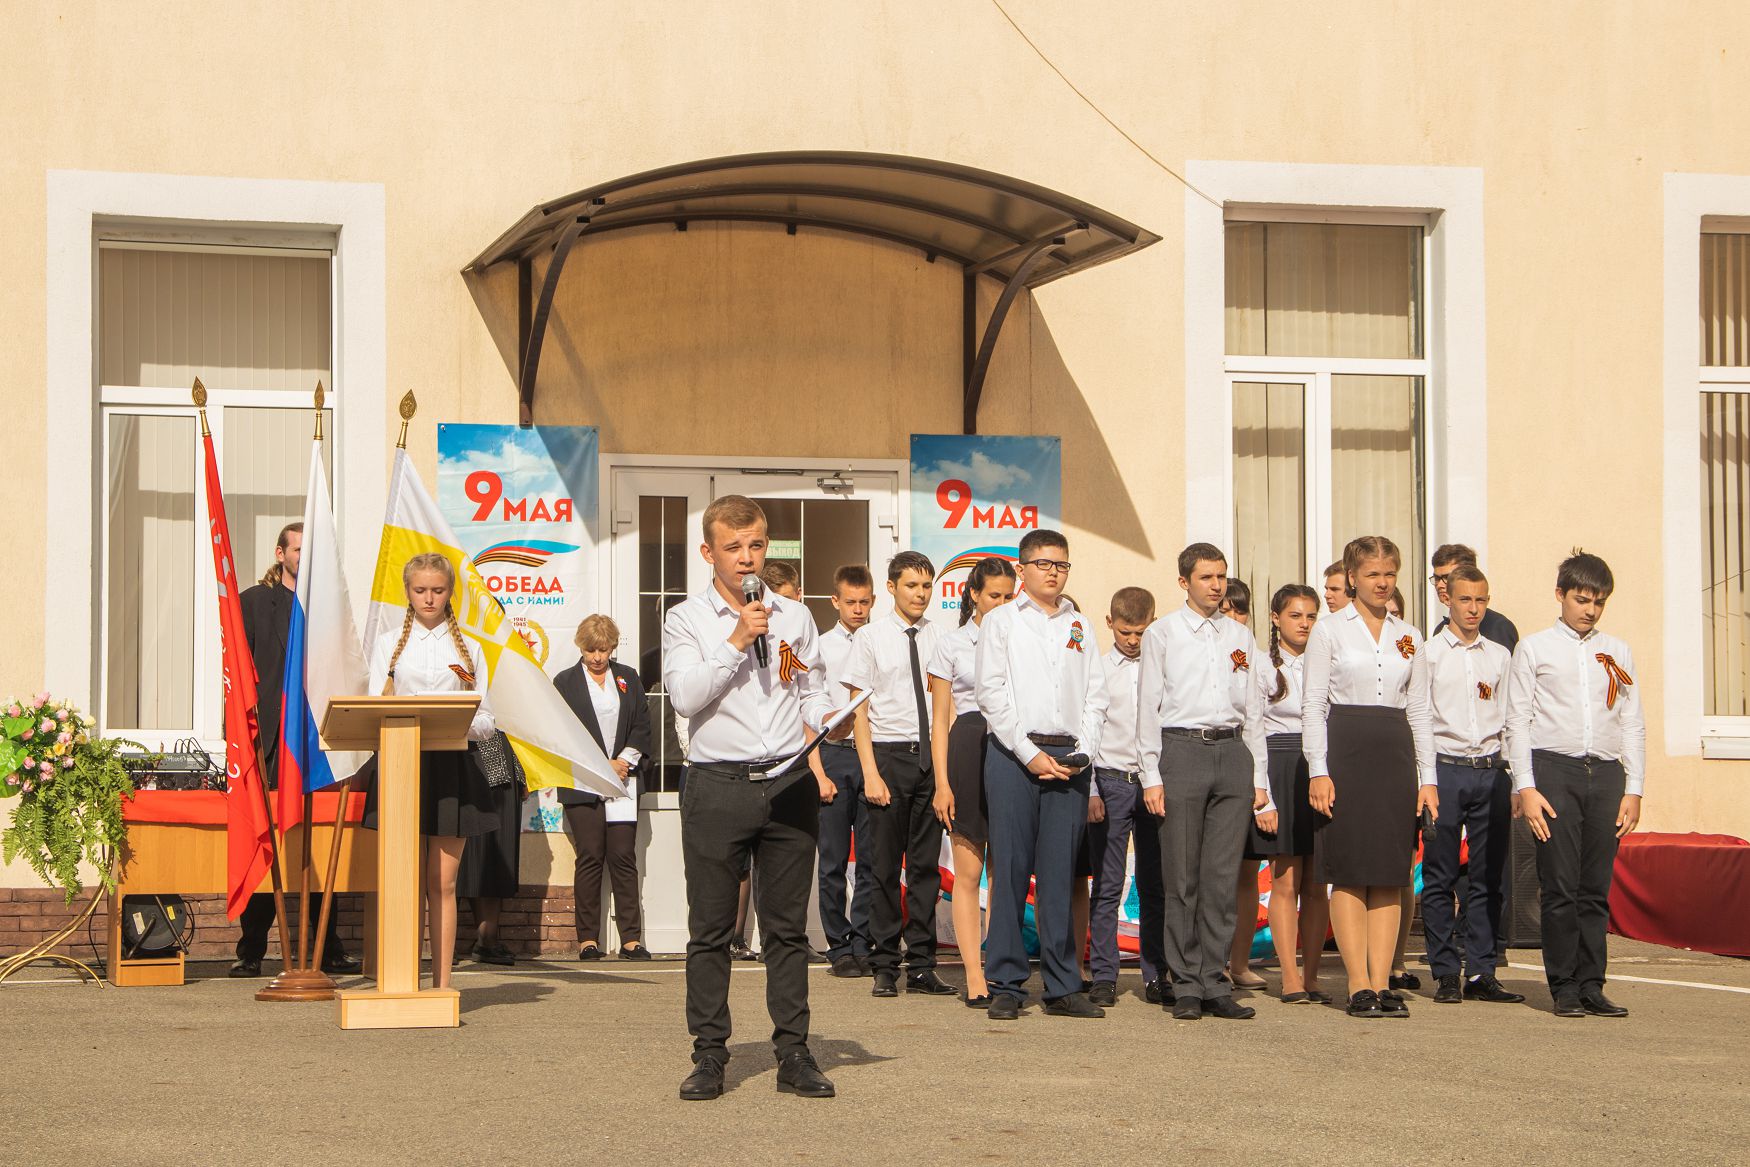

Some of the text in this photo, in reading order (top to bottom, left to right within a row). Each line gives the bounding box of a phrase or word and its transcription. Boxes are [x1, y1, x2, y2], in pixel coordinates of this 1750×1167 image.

[503, 497, 573, 523] МАЯ
[972, 505, 1039, 529] МАЯ
[481, 575, 564, 595] ОБЕДА
[527, 596, 565, 605] НАМИ!
